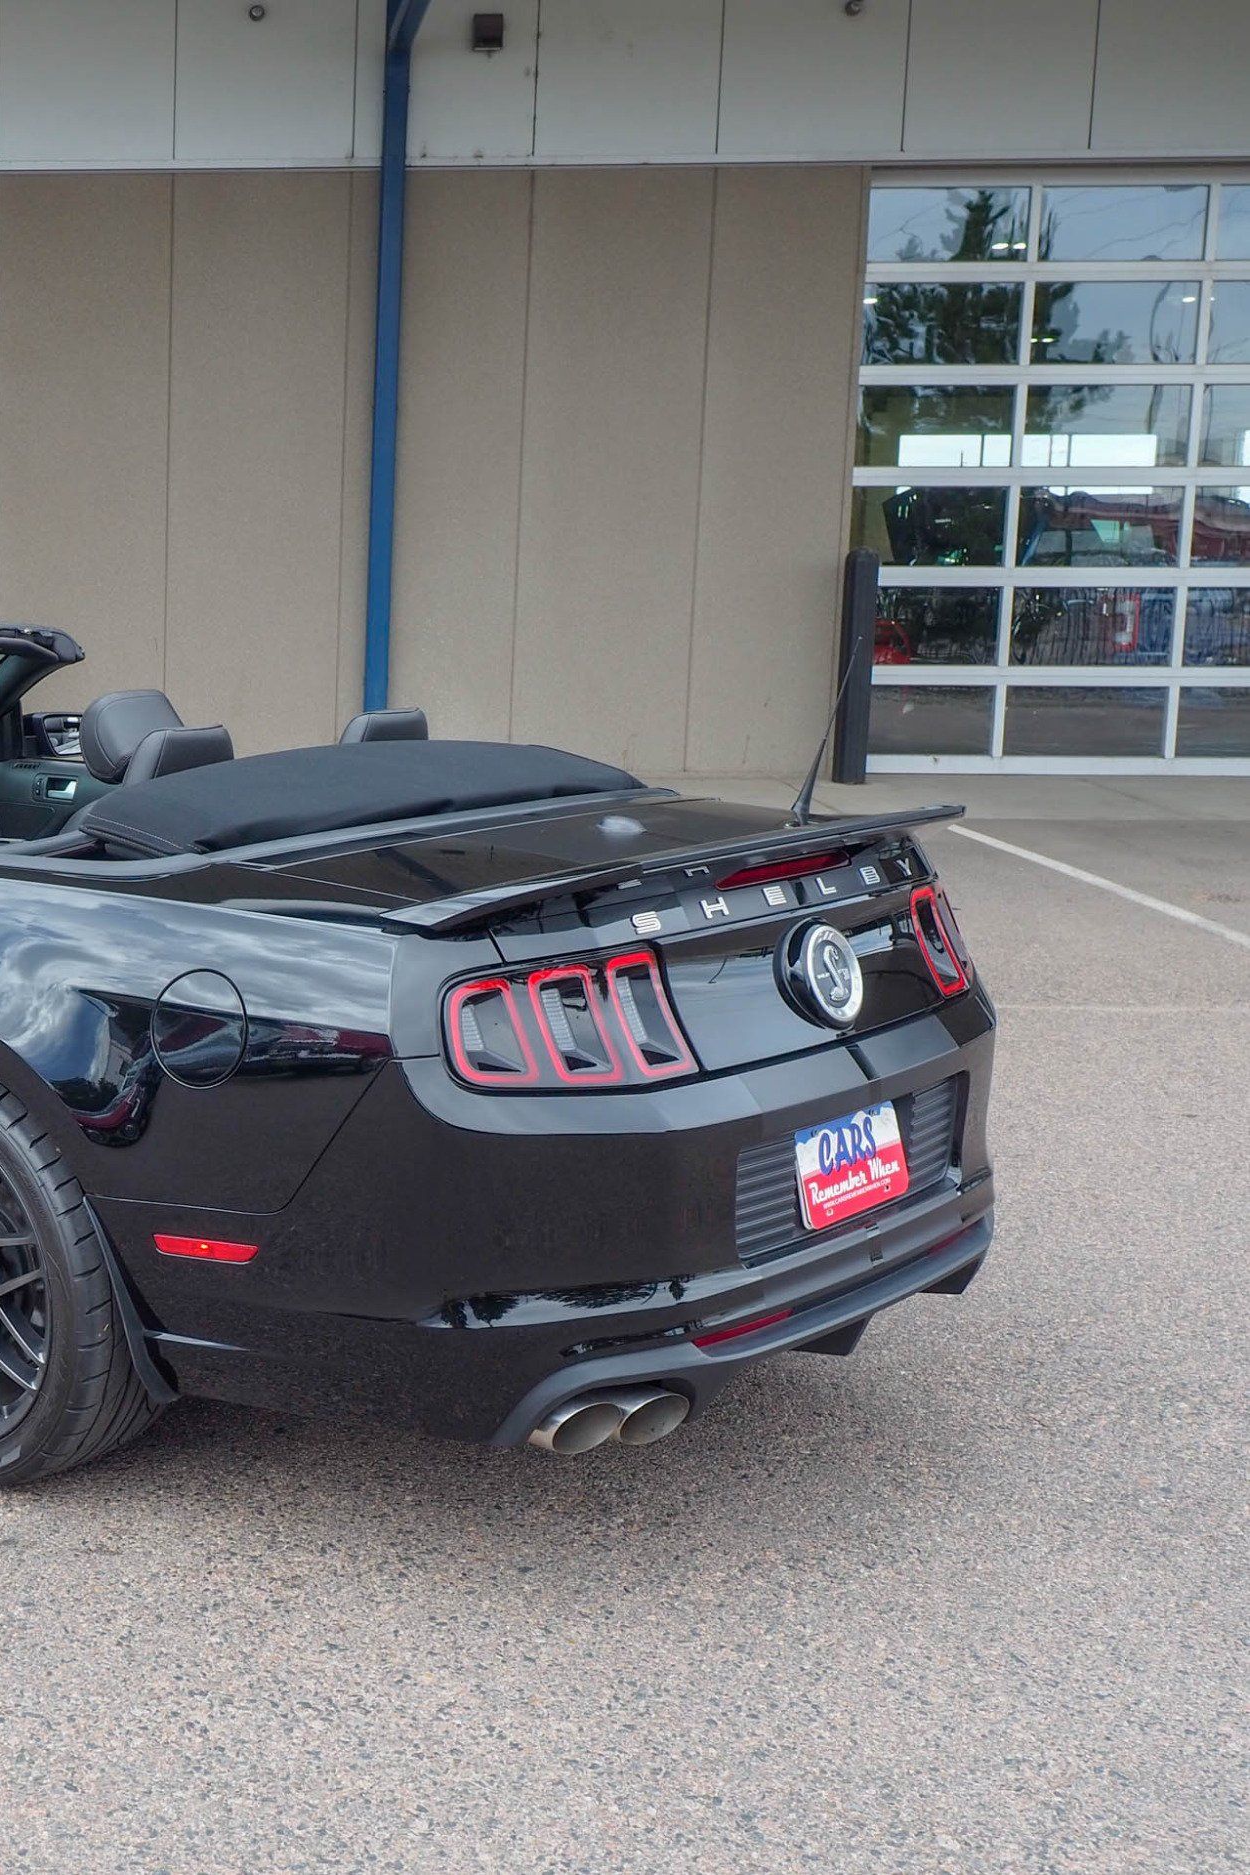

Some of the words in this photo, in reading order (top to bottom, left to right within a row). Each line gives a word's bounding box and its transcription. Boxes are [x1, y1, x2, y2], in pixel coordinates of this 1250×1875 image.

[631, 858, 913, 935] SHELBY
[818, 1116, 876, 1176] CARS
[809, 1170, 868, 1206] Remember
[867, 1157, 901, 1181] When
